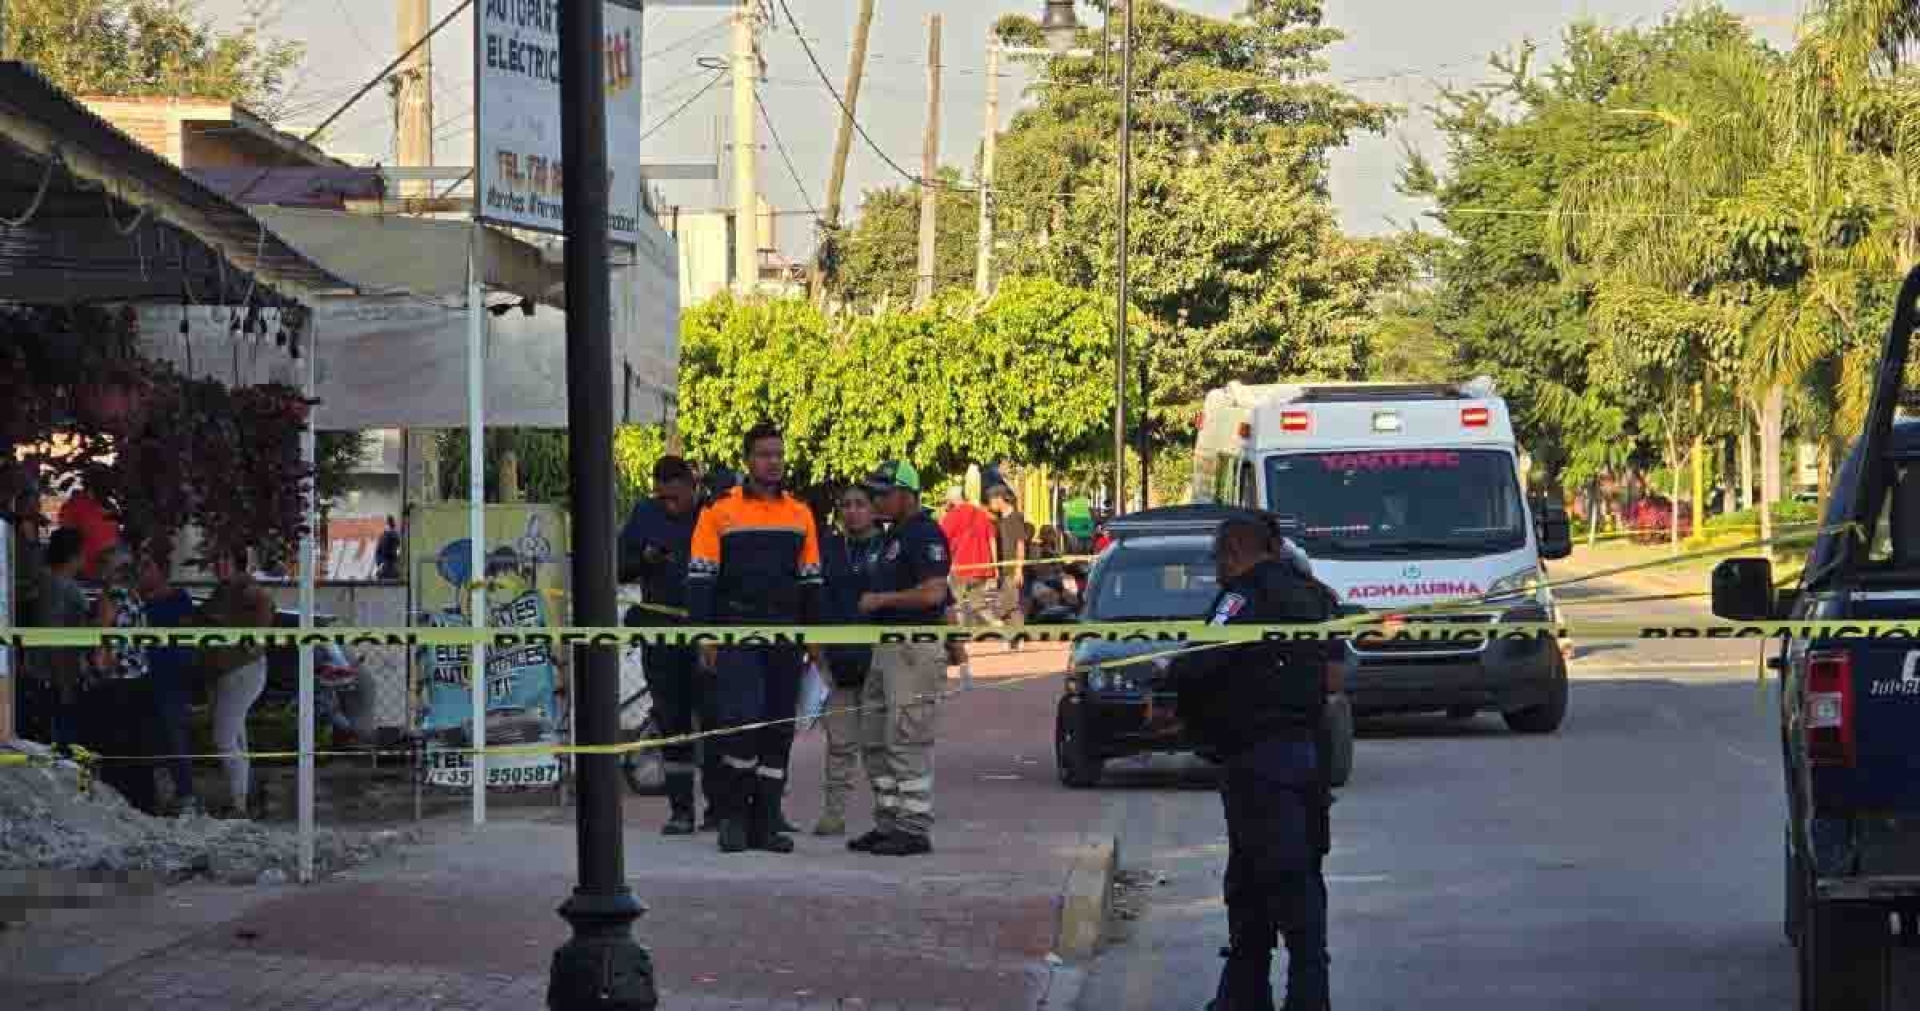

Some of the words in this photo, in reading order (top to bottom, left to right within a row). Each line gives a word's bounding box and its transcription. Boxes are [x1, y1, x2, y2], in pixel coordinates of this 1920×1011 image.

[486, 30, 561, 84] ELÉCTRIC
[879, 627, 1188, 643] PRECAUCIÓN
[1259, 624, 1568, 641] PRECAUCIÓN
[1639, 623, 1920, 640] PRECAUCIÓ
